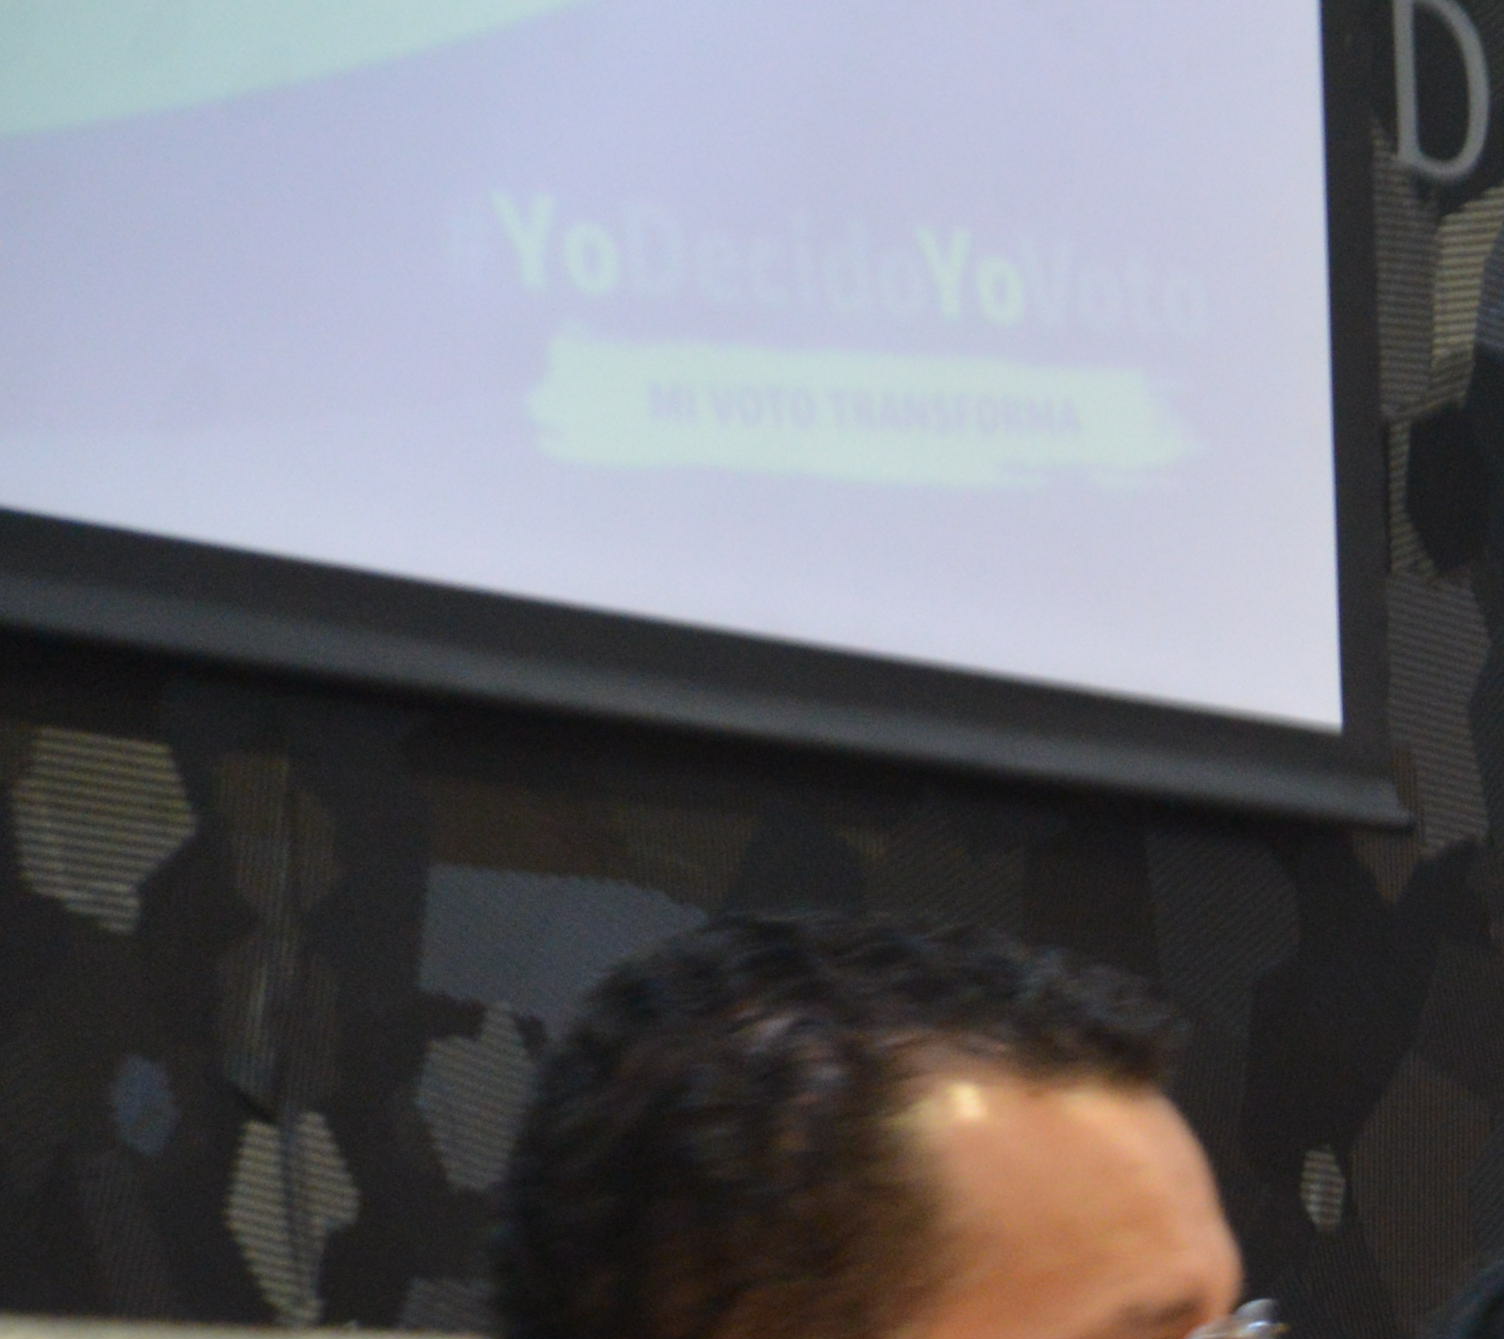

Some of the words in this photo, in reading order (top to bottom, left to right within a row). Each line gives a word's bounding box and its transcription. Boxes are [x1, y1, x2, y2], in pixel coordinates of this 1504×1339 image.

[1394, 0, 1489, 181] D
[647, 380, 694, 425] MI
[714, 383, 816, 429] VOTO
[829, 386, 1082, 434] TRANSFORMA
